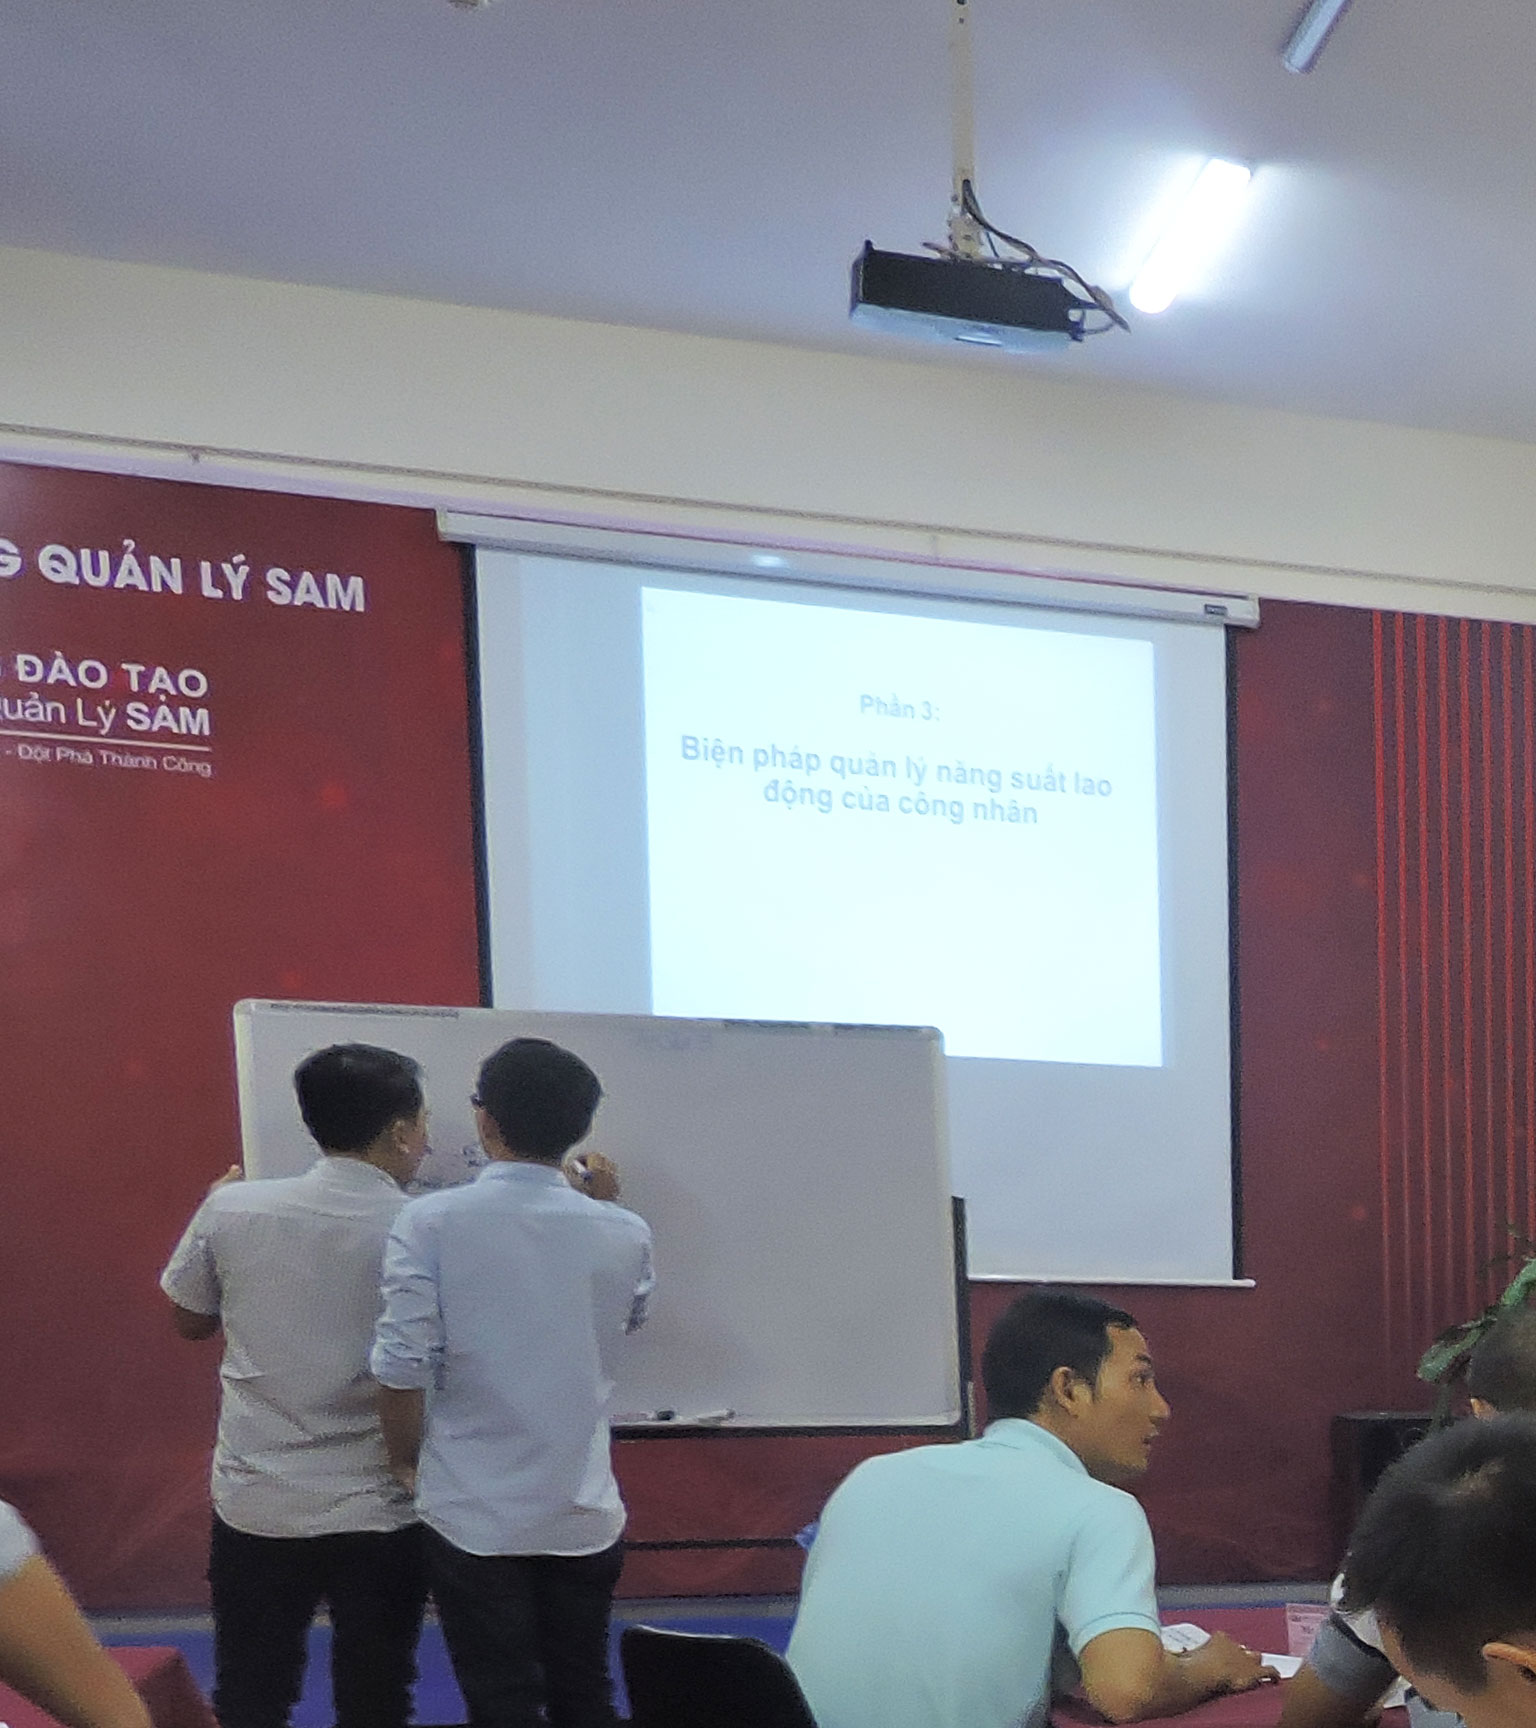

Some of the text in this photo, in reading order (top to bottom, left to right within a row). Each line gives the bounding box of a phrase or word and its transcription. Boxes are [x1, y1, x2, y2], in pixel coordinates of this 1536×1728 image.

[38, 538, 182, 595] QUẢN
[200, 553, 250, 600] LÝ
[266, 567, 366, 613] SAM
[16, 650, 209, 701] ĐÀO TẠO
[0, 691, 211, 736] uản Lý SAM
[681, 734, 744, 768] Biện
[752, 743, 821, 772] pháp
[1074, 771, 1113, 797] lao
[763, 780, 834, 812] động
[898, 791, 965, 825] công
[973, 798, 1039, 824] nhân
